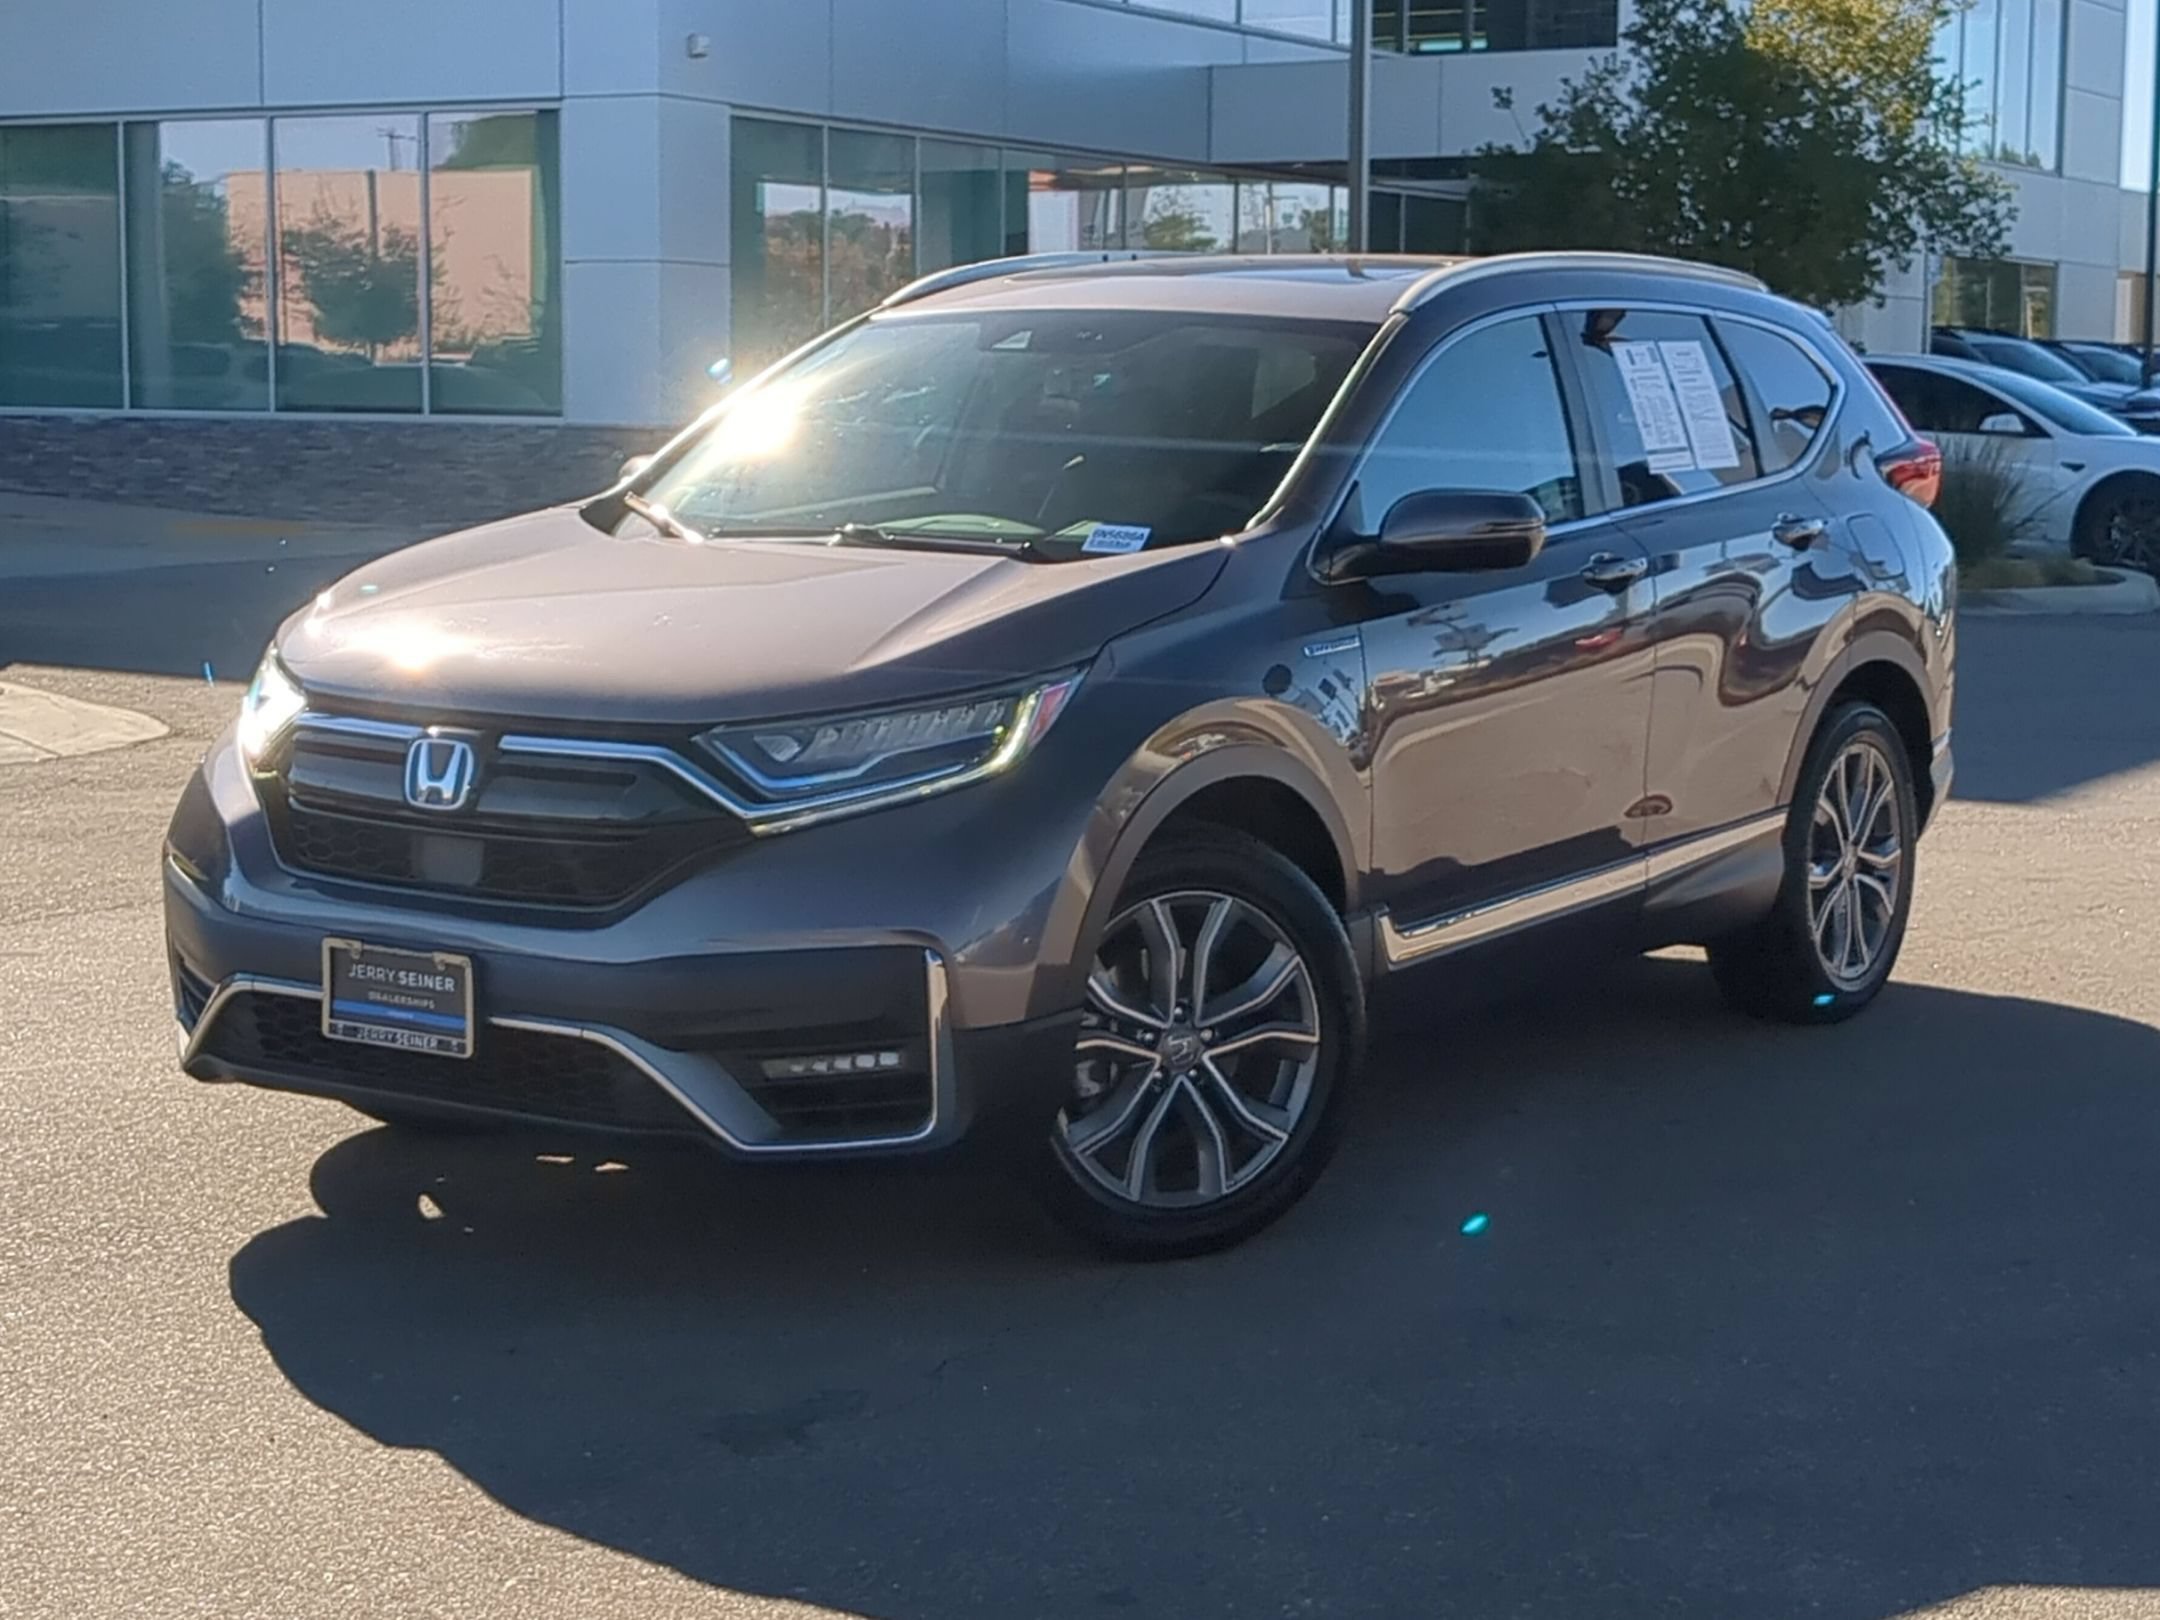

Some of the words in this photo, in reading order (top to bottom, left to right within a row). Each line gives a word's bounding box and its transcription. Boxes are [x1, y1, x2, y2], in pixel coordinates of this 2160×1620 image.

[349, 963, 396, 983] JERRY
[397, 970, 455, 992] SEINER
[356, 1026, 394, 1042] JERRY
[396, 1033, 438, 1049] SEINER
